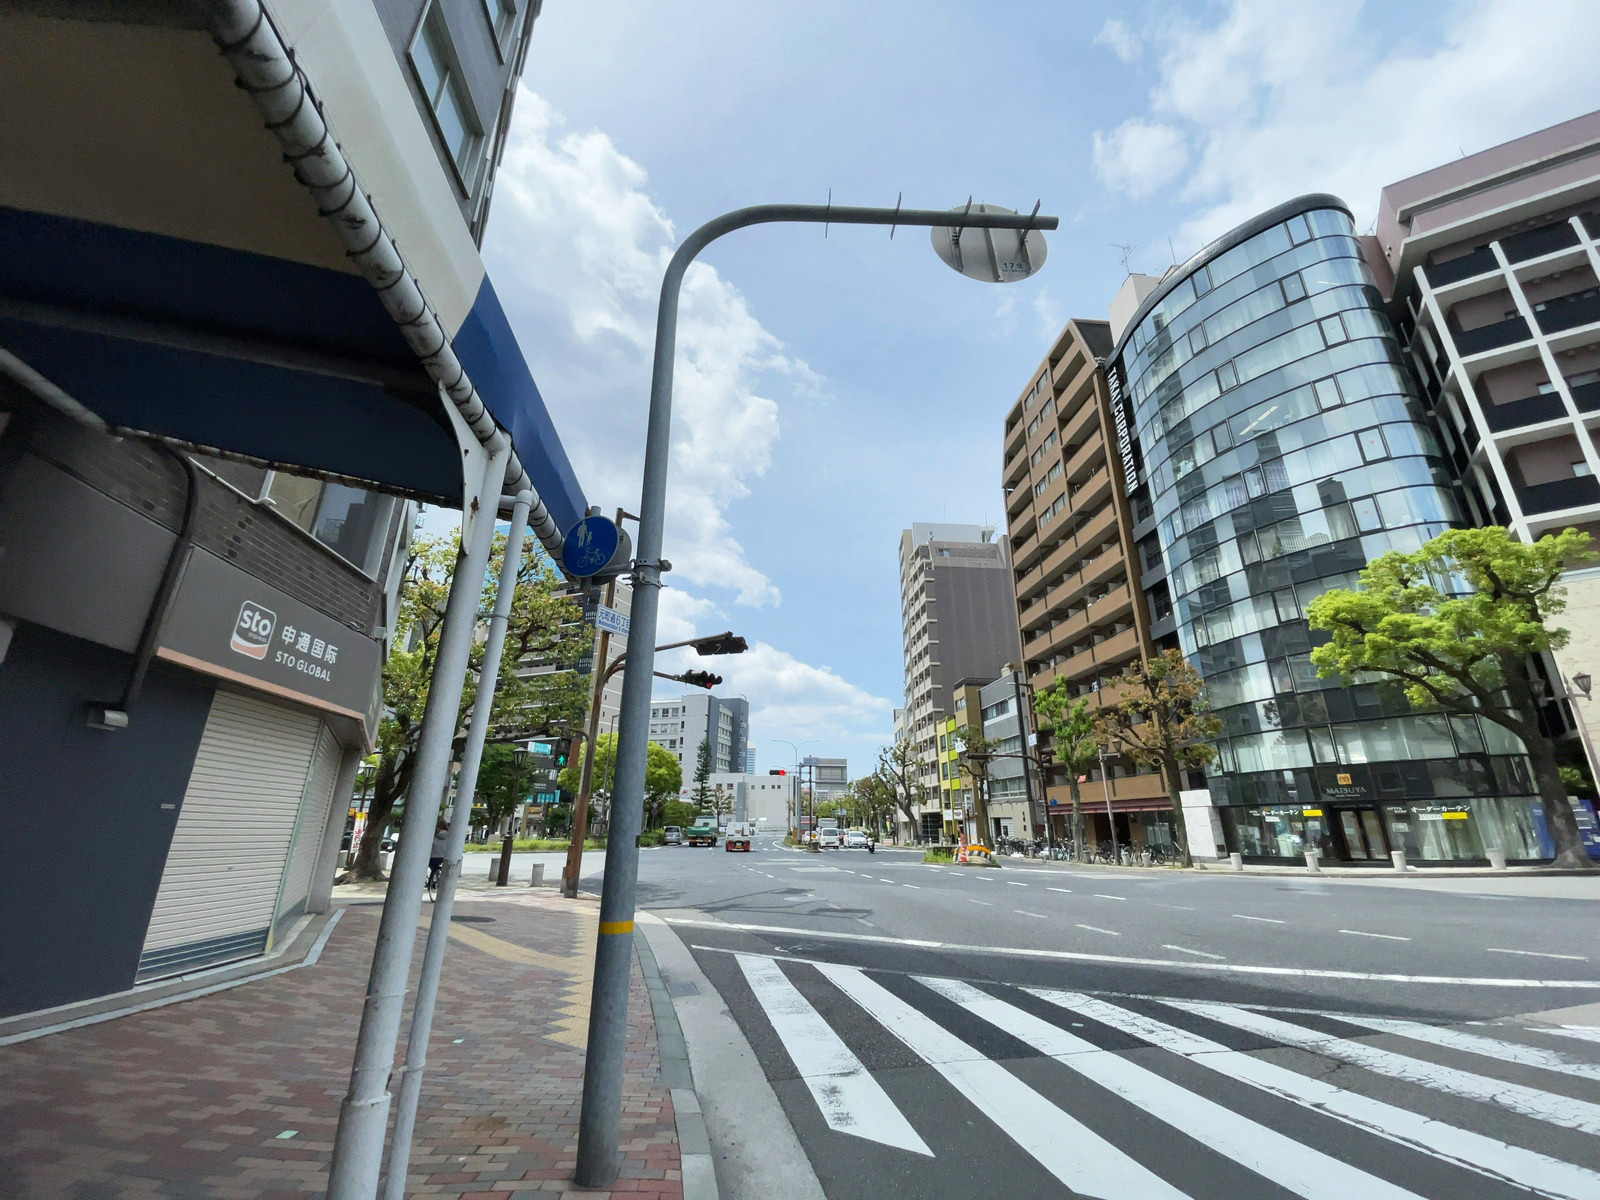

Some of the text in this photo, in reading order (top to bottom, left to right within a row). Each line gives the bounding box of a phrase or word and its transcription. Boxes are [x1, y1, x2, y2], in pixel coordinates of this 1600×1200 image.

[1107, 366, 1139, 493] TAKAI CORPORATION
[239, 609, 271, 636] sto
[281, 625, 338, 664] 申通国际
[275, 651, 331, 682] STO GLOBAL
[1326, 786, 1366, 794] MATSUYA
[1410, 804, 1471, 813] オーダーカーテン
